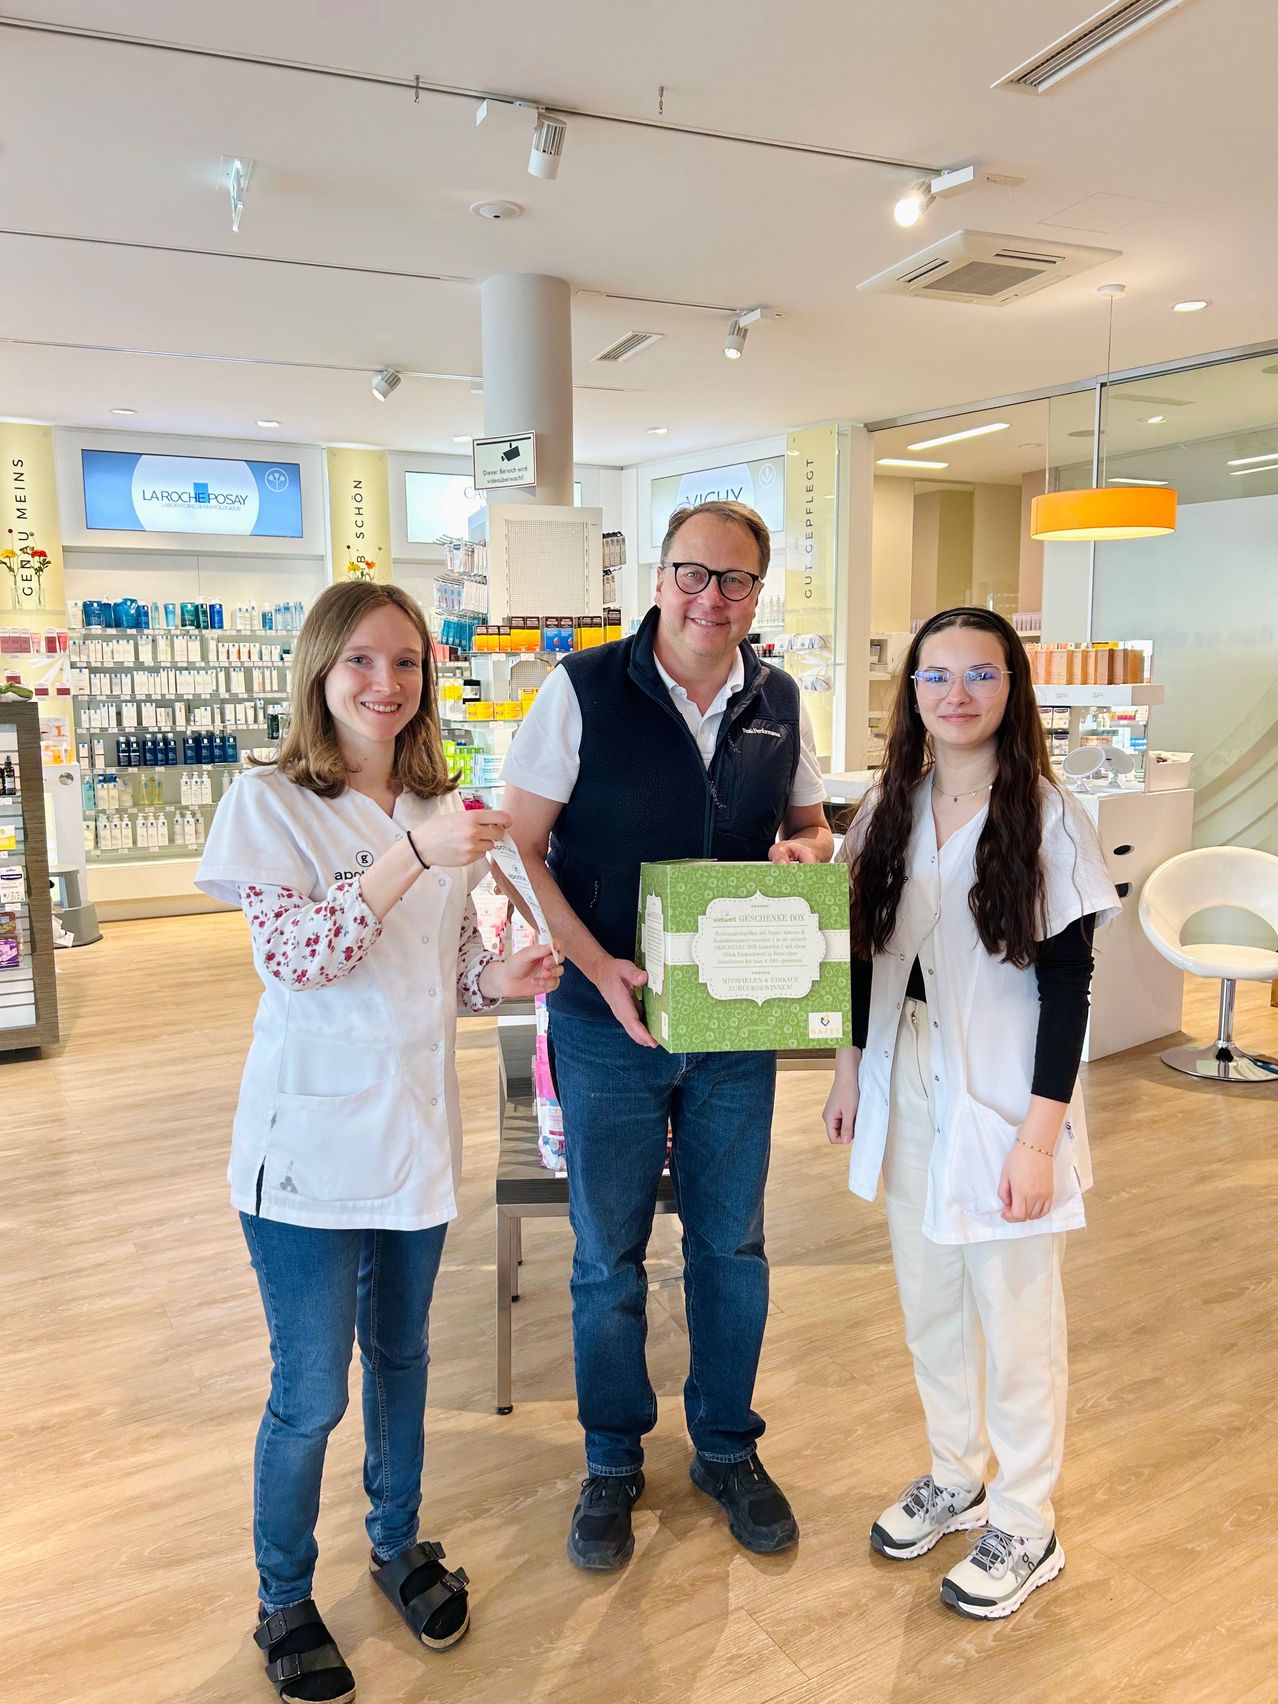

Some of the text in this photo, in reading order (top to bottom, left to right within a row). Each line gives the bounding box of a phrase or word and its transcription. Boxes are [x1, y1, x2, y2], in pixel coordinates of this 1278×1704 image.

[142, 489, 248, 506] LA ROCHE POSAY
[352, 480, 365, 539] SCHÖN
[686, 486, 743, 508] VICHY
[12, 459, 33, 596] GENAU MEINS
[805, 459, 814, 599] GUT GEPFLEGT
[739, 913, 788, 922] GESCHENKE
[790, 913, 805, 921] BOX
